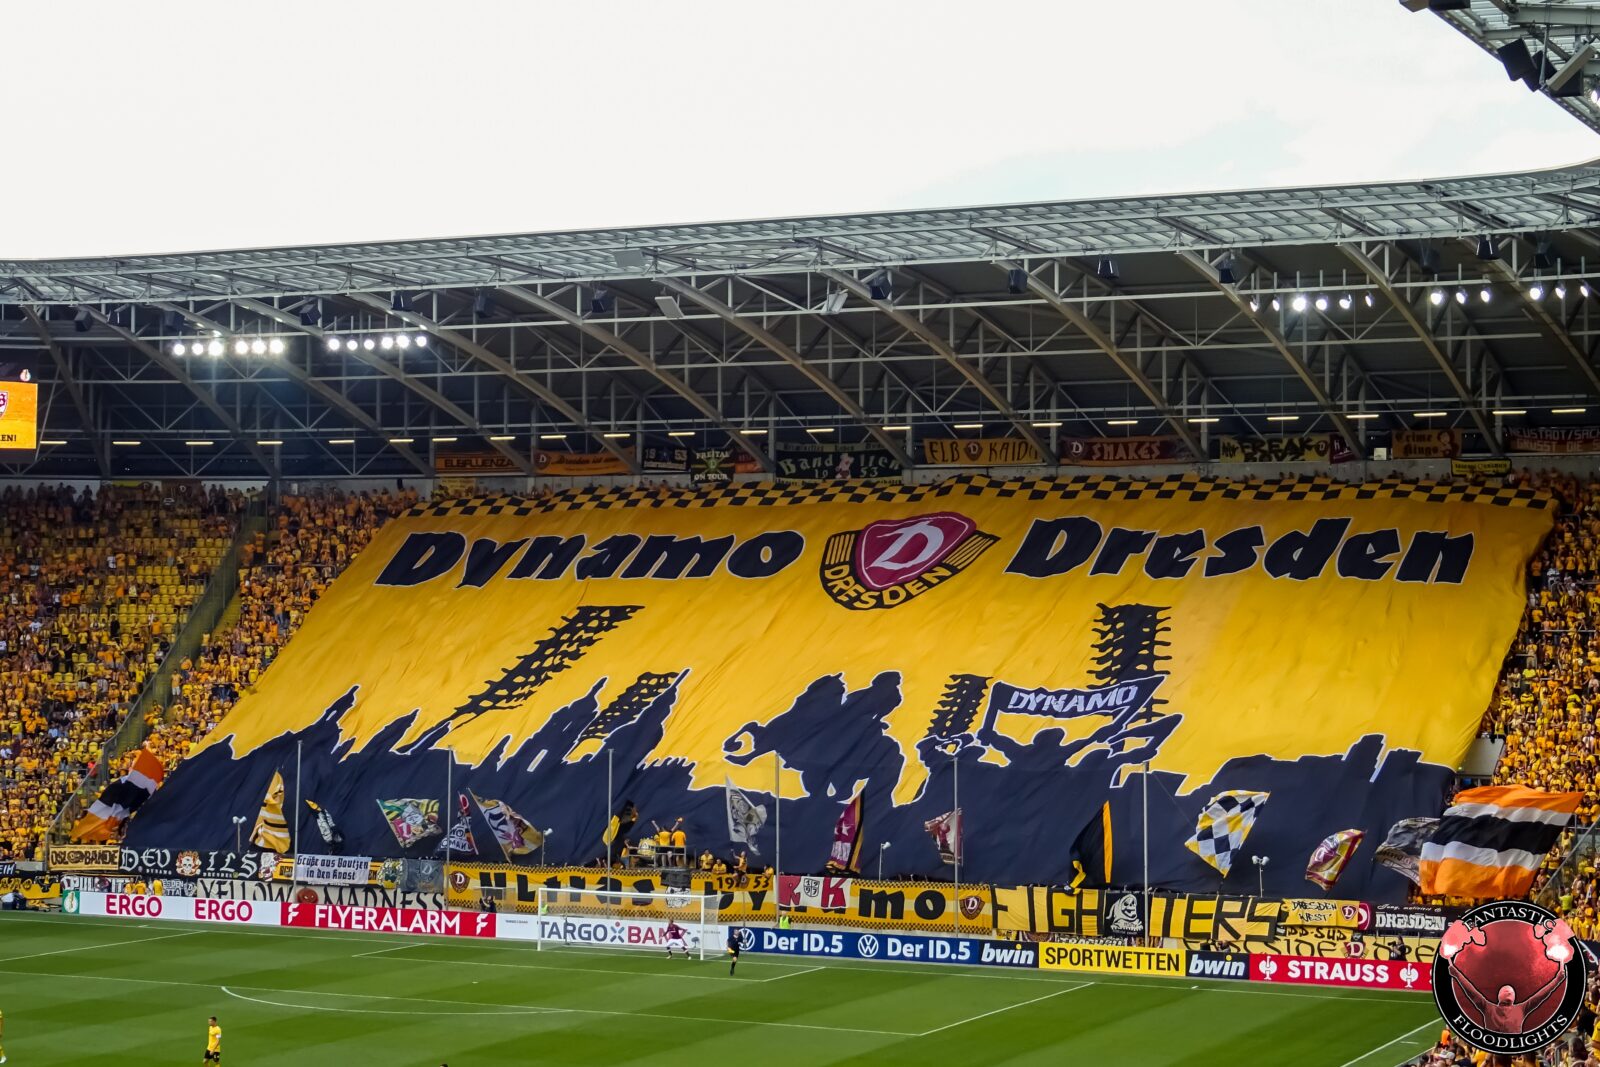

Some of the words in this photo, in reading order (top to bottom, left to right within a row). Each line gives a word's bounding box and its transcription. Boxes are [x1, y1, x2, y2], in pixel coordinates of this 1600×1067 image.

[0, 434, 17, 442] EN!
[1092, 440, 1161, 460] SNAKES
[696, 449, 730, 460] FREITAL
[929, 441, 960, 462] ELB
[373, 529, 805, 589] Dynamo
[1004, 515, 1475, 585] Dresden
[824, 563, 953, 609] DRESDEN
[1008, 684, 1139, 712] DYNAMO
[105, 893, 163, 917] ERGO
[194, 898, 253, 922] ERGO
[314, 904, 461, 935] FLYERALARM
[1375, 911, 1447, 931] DRESDEN
[763, 930, 798, 950] Der
[803, 933, 844, 953] ID.5
[887, 937, 924, 958] Der
[928, 939, 971, 961] ID.5
[980, 942, 1036, 965] bwin
[1045, 946, 1180, 972] SPORTWETTEN
[1188, 953, 1246, 977] bwin
[1287, 959, 1390, 984] STRAUSS
